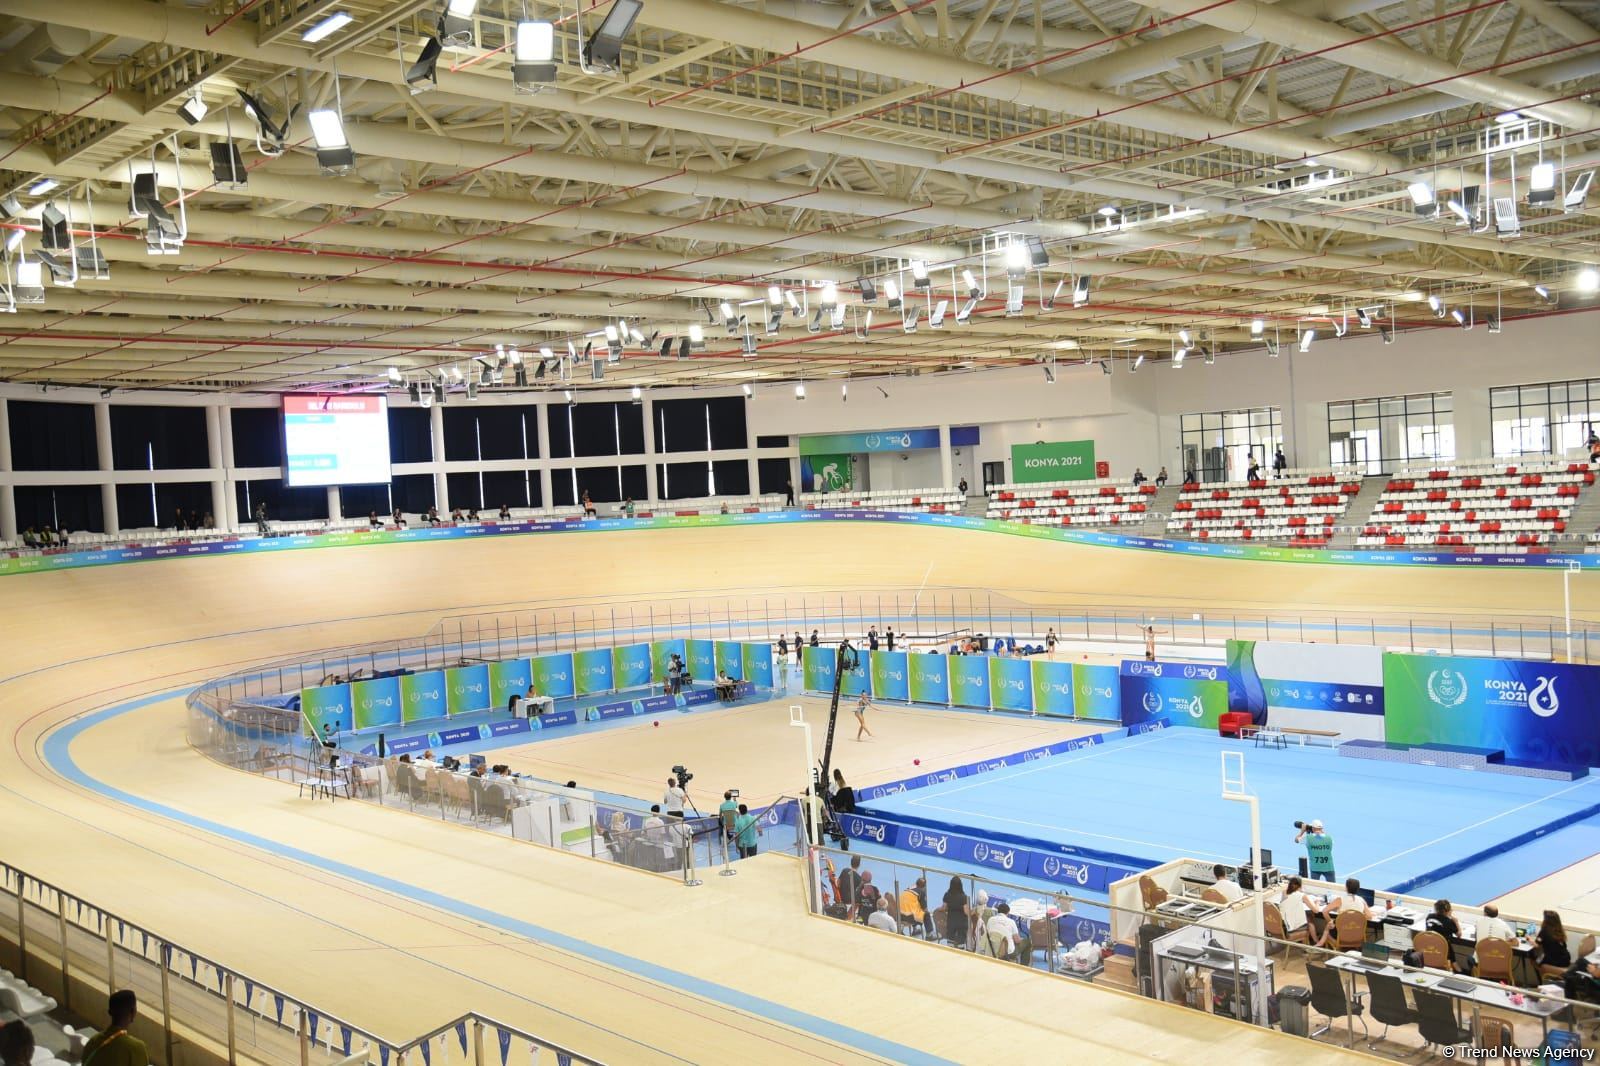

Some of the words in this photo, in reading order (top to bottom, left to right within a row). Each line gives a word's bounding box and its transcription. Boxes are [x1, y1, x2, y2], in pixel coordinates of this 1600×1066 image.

[1024, 458, 1059, 468] KONYA
[1060, 456, 1082, 466] 2021
[1484, 679, 1526, 691] KONYA
[1498, 690, 1528, 701] 2021
[1314, 856, 1329, 864] 739
